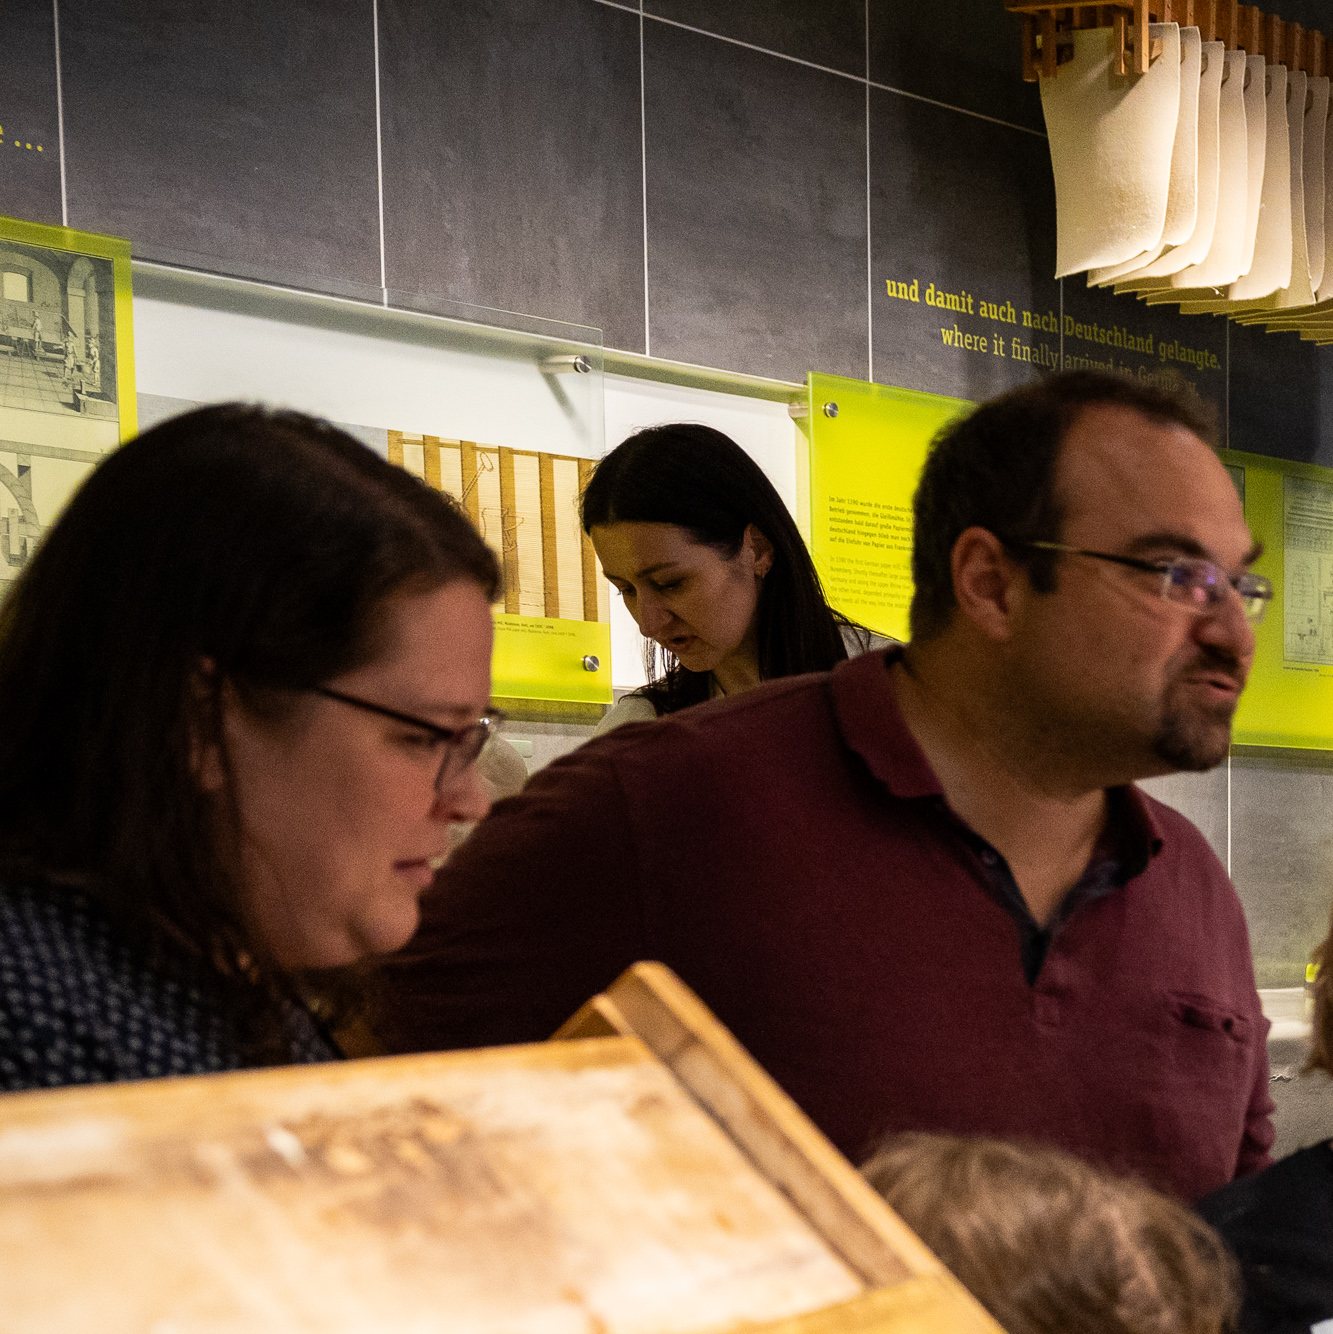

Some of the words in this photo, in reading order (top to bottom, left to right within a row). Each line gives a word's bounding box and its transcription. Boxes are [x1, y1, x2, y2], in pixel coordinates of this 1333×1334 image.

[886, 279, 920, 303] und
[925, 283, 974, 315] damit
[979, 301, 1017, 324] auch
[1022, 309, 1059, 334] nach
[1064, 314, 1154, 355] Deutschland
[1158, 339, 1221, 371] gelangte.
[940, 323, 988, 353] where
[992, 333, 1006, 357] it
[1011, 337, 1058, 372] finally
[836, 496, 845, 504] Jahr
[829, 506, 845, 514] Betrieb
[829, 526, 856, 535] deutschland
[857, 529, 877, 538] hingegen
[871, 541, 885, 549] Papier
